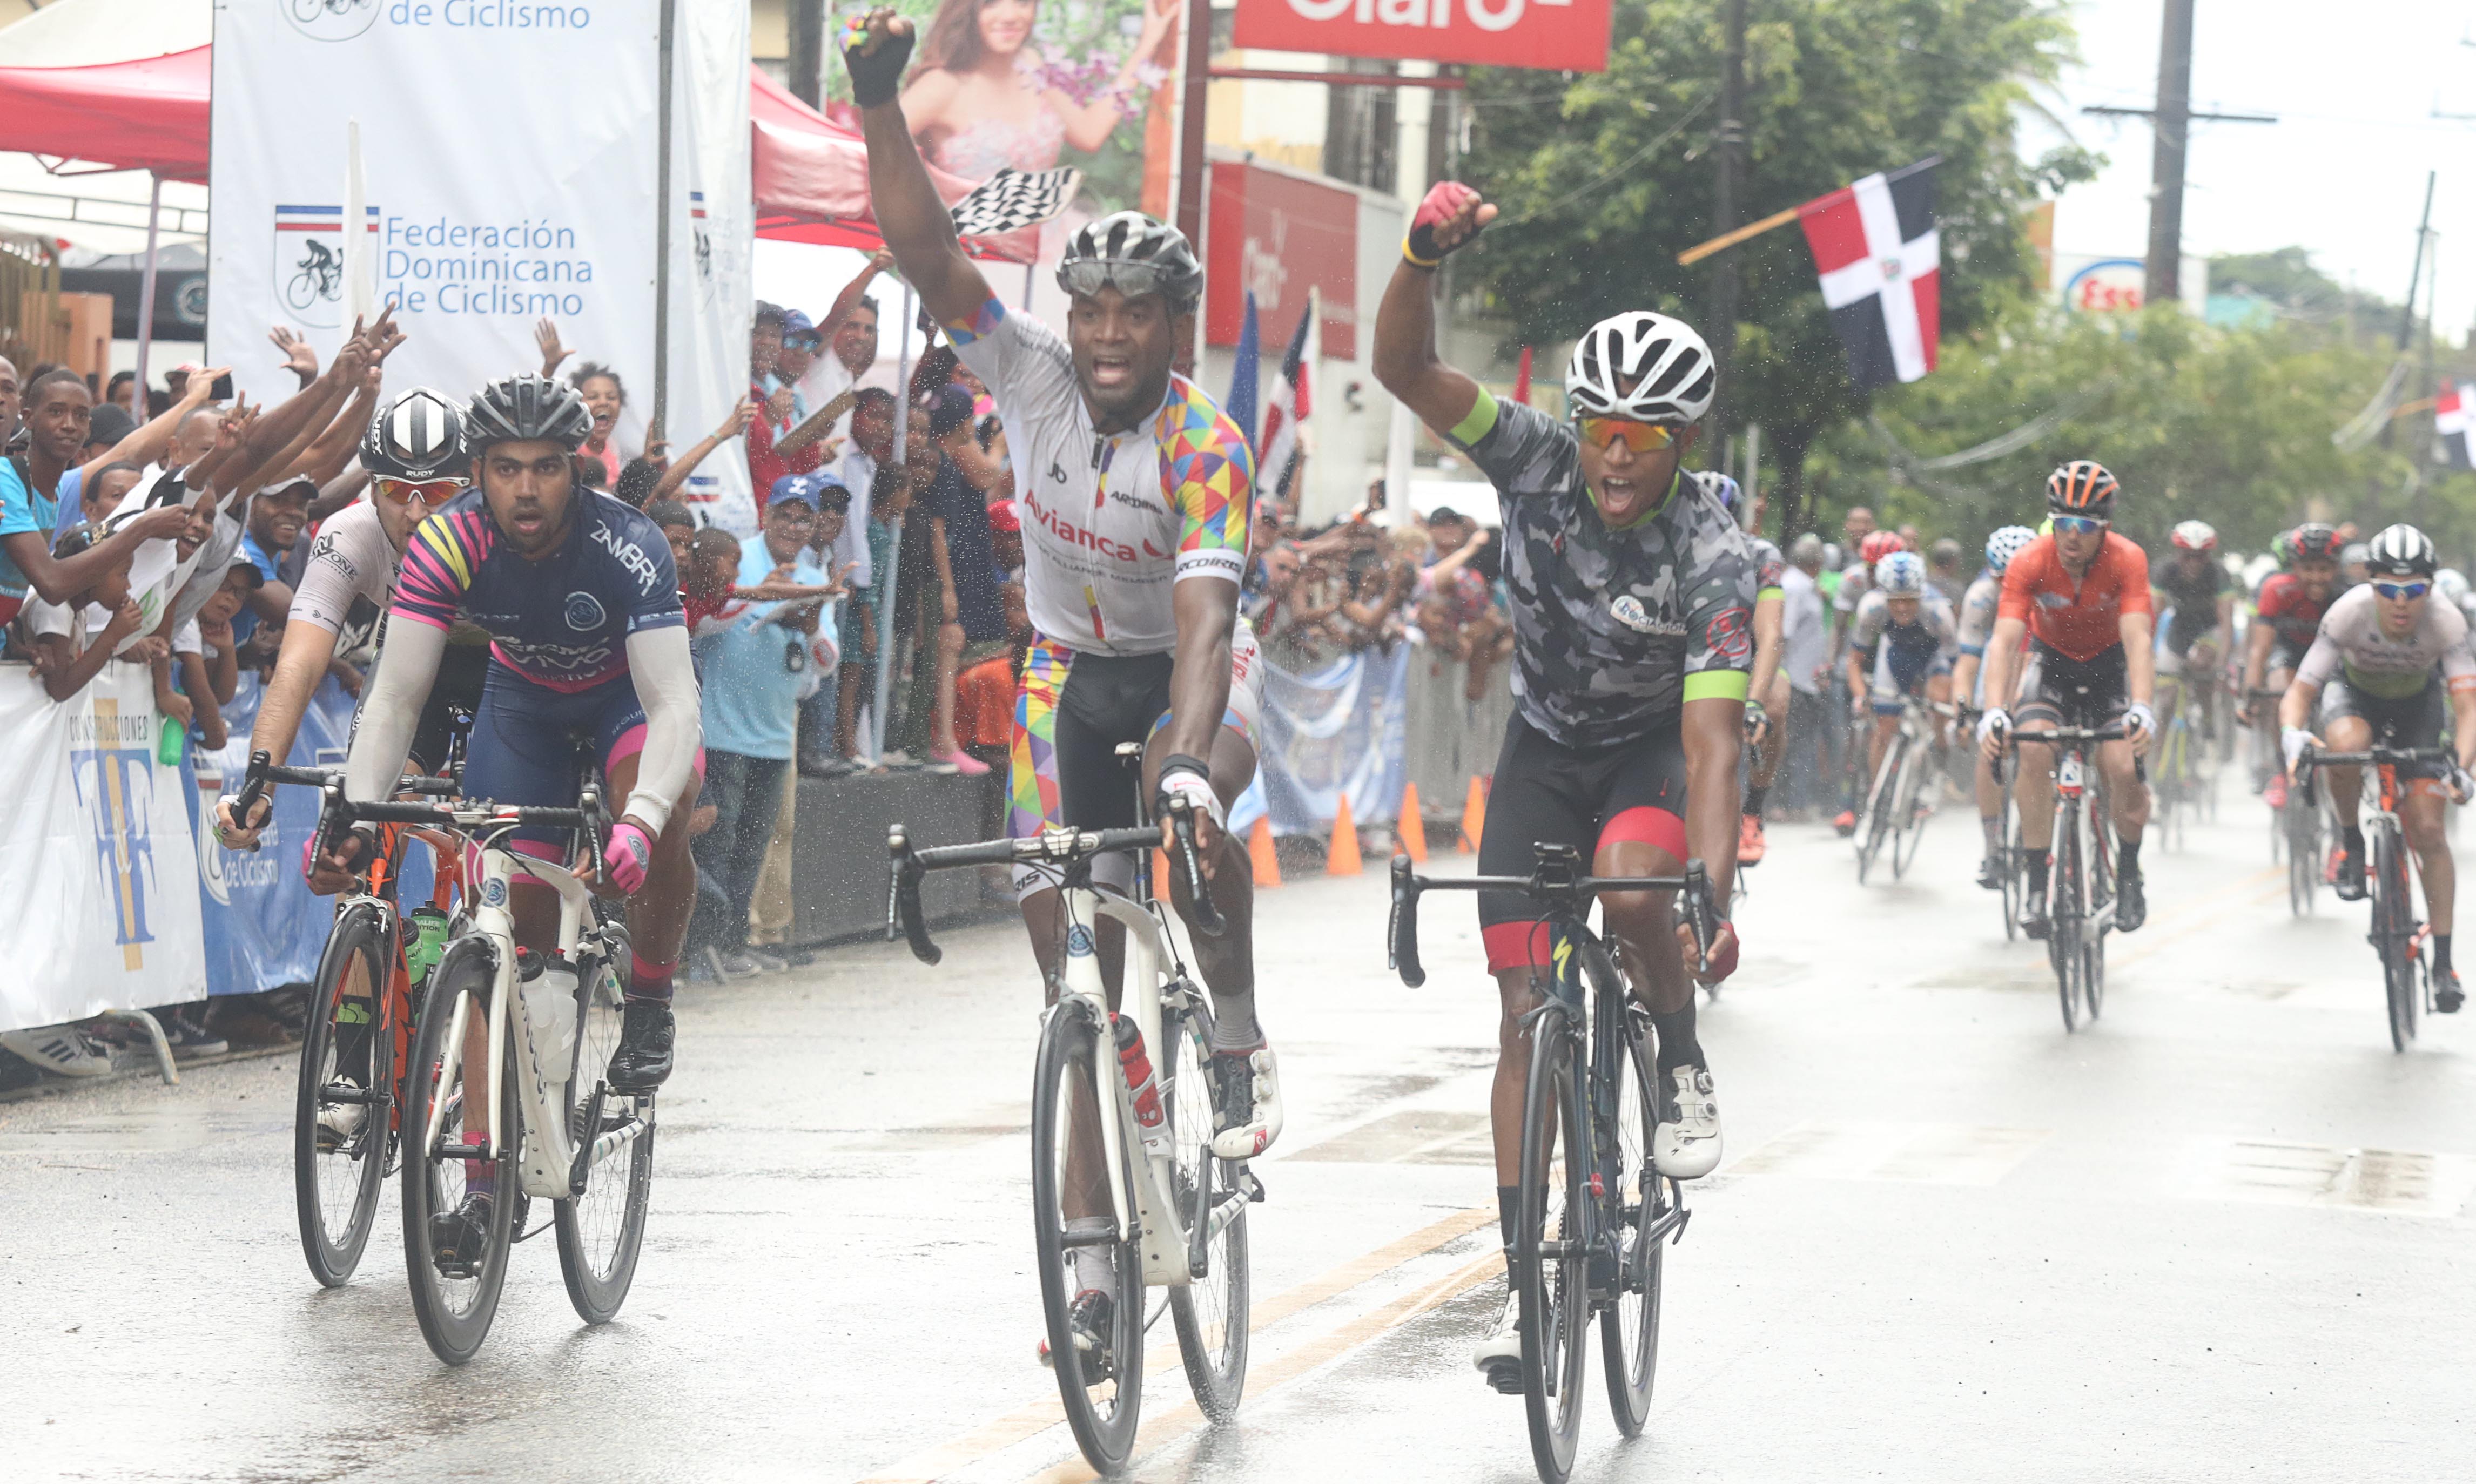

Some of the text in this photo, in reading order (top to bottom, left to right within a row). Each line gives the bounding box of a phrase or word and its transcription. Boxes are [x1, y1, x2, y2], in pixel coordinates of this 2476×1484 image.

[389, 0, 590, 28] de Ciclismo
[387, 217, 575, 249] Federación
[386, 249, 593, 282] Dominicana
[384, 282, 583, 316] de Ciclismo
[2081, 278, 2143, 310] Ess
[406, 469, 435, 477] RUDY
[1024, 488, 1137, 562] Avianca
[69, 715, 148, 741] CONSTRUCCIONES
